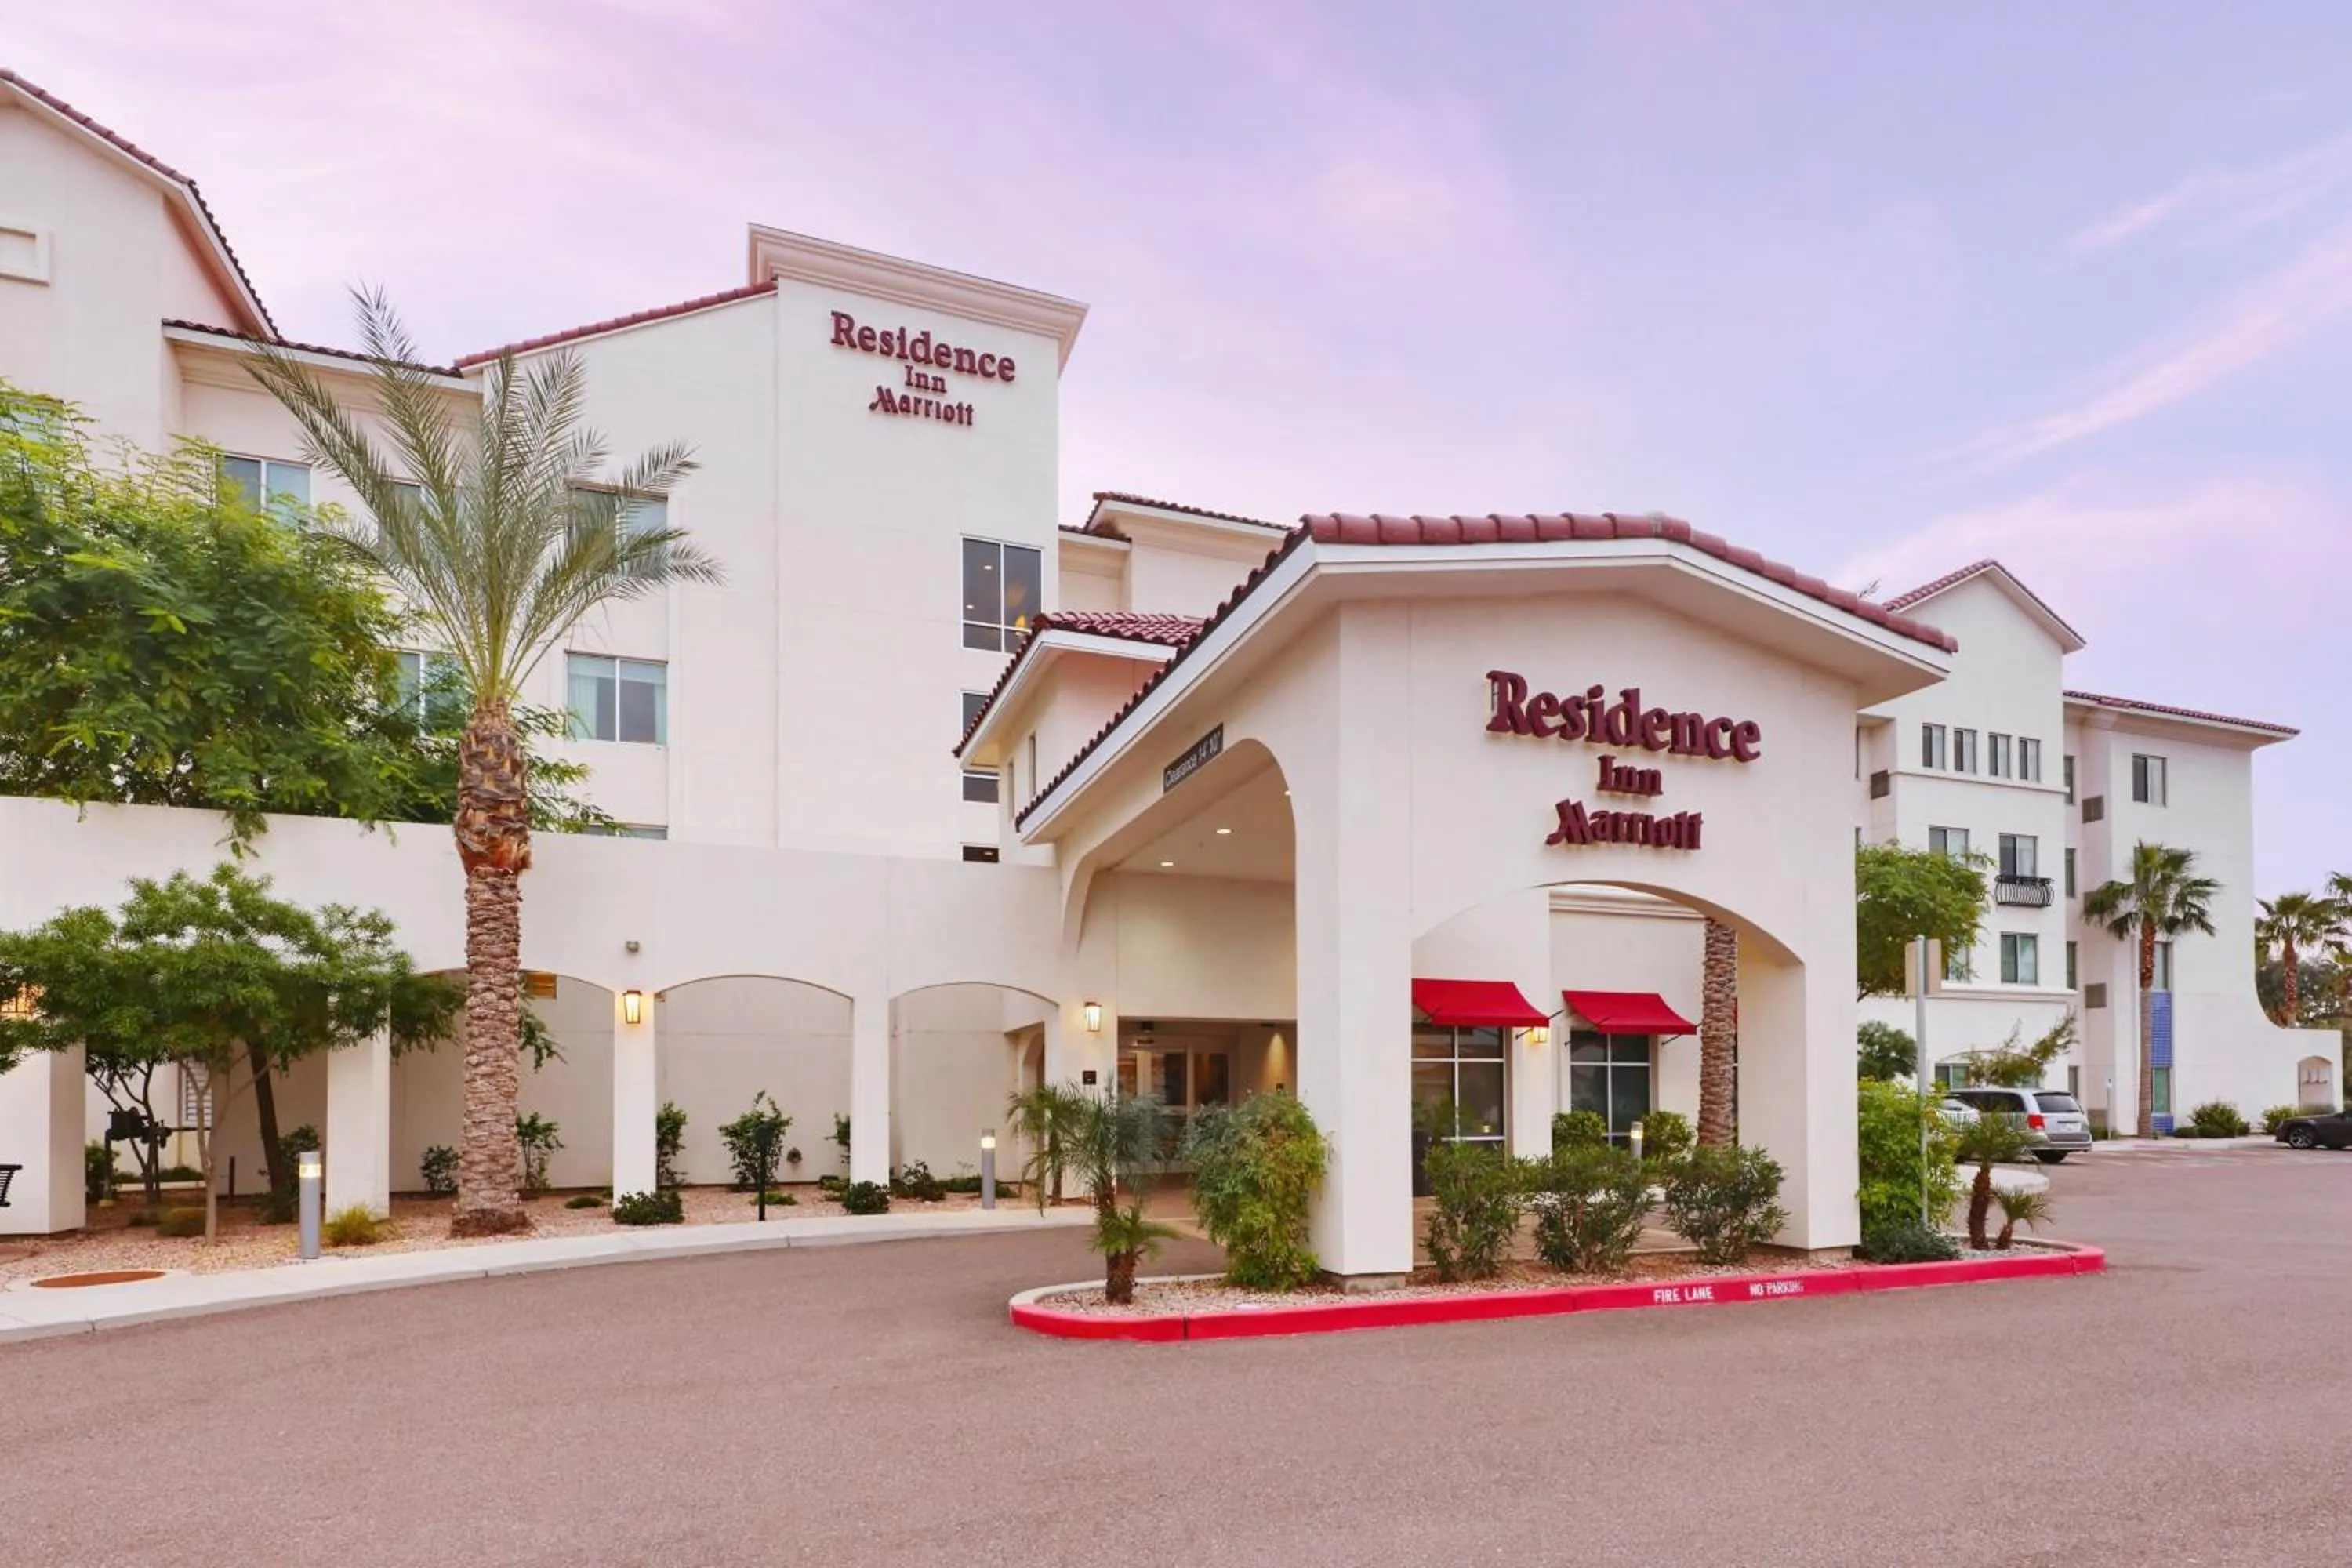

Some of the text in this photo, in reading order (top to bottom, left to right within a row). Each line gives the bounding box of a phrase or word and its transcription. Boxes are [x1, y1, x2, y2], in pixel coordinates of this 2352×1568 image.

[830, 310, 1015, 381] Residence
[904, 365, 947, 393] Inn
[869, 385, 974, 426] Marriott
[1486, 670, 1761, 763] Residence
[1596, 754, 1663, 797] Inn
[1545, 798, 1703, 850] Marriott
[1653, 1286, 1715, 1303] FIRE LANE
[1749, 1280, 1804, 1296] NO PARKING
